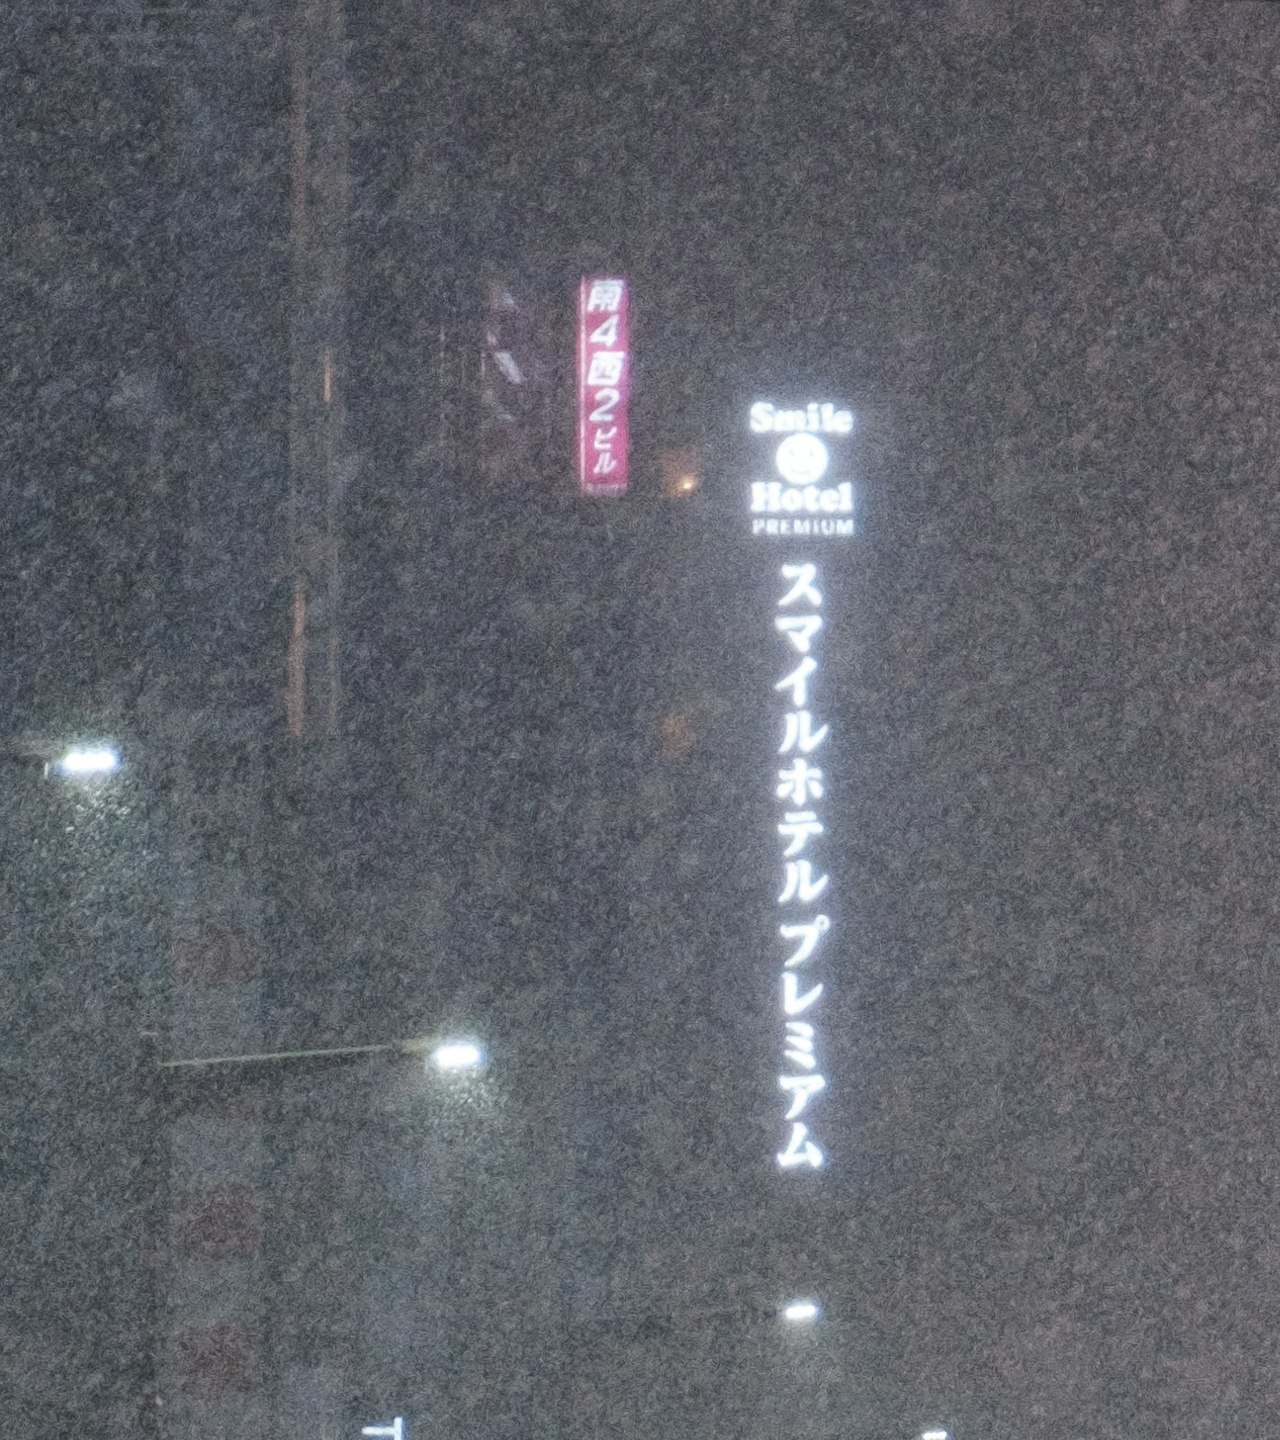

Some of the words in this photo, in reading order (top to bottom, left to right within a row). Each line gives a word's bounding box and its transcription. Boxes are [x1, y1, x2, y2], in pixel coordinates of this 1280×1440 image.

[750, 401, 854, 434] Smile
[750, 481, 853, 513] Hotel
[752, 518, 855, 536] PREMIUM
